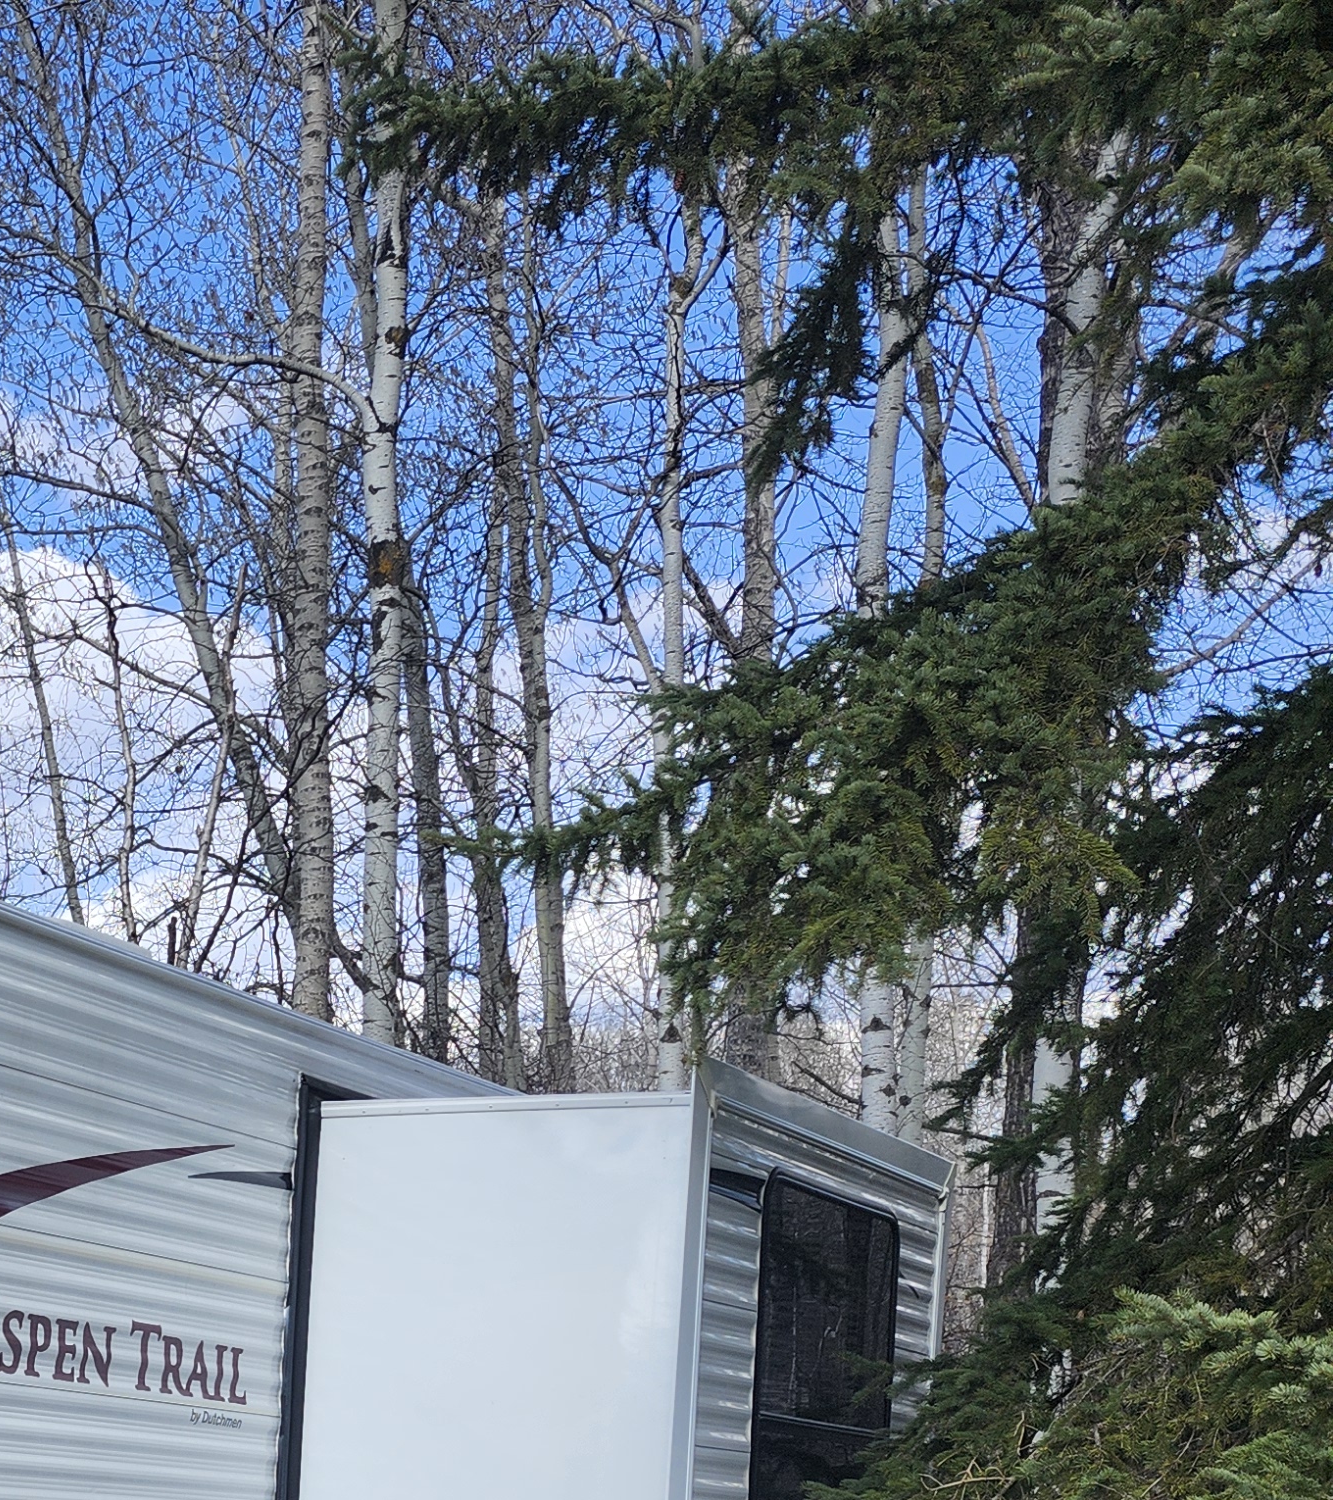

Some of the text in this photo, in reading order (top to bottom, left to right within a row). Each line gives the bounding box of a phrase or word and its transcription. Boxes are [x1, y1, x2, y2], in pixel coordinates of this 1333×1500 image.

[130, 1319, 248, 1405] TRAIL
[189, 1408, 242, 1429] by Dutchmen
